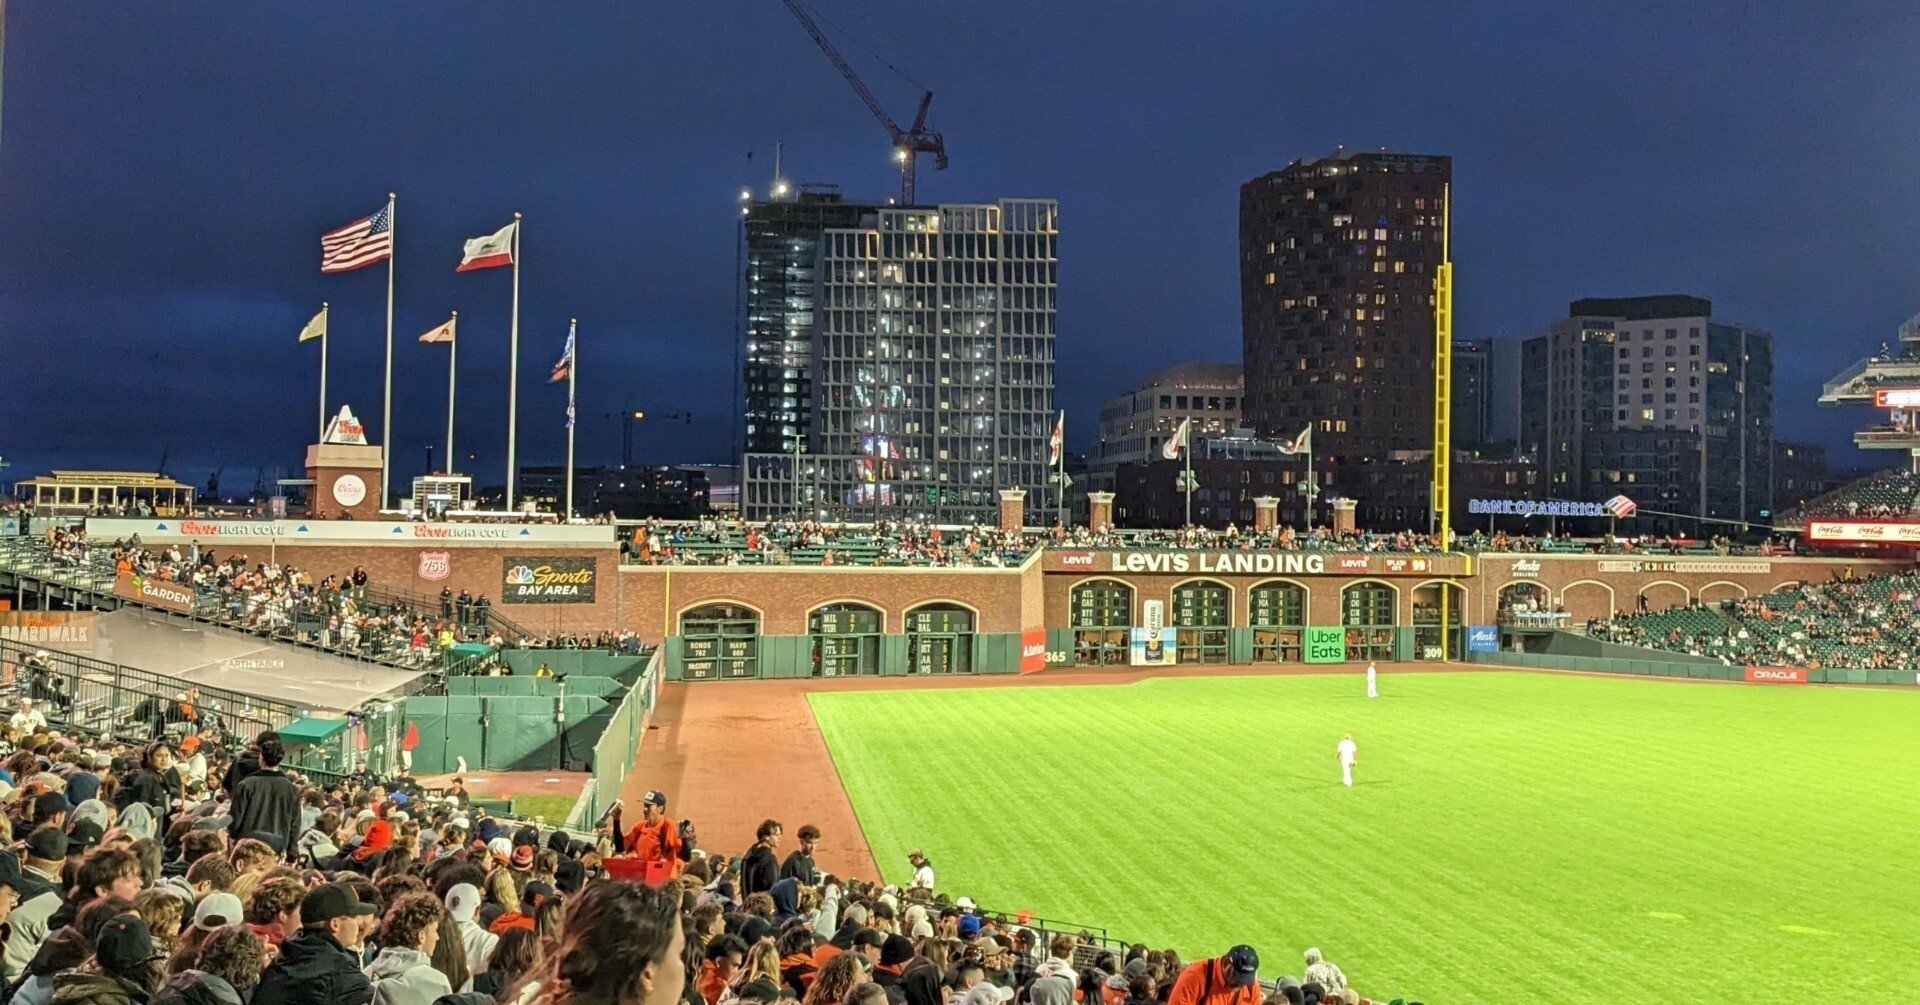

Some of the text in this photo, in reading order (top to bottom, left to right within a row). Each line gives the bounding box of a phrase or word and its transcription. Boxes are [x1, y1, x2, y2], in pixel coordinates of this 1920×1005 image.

[1469, 499, 1603, 517] BANK OF AMERICA
[181, 520, 285, 535] Coors LIGHT COVE
[414, 524, 509, 538] Coors LIGHT COVE
[1818, 526, 1844, 534] Coca-Cola
[1858, 526, 1884, 535] Coca-Cola
[424, 561, 446, 571] 756
[1200, 553, 1324, 573] LANDING
[1511, 560, 1541, 572] Alaska
[532, 565, 593, 587] Sports
[142, 585, 191, 604] GARDEN
[518, 585, 578, 595] BAY AREA
[1082, 590, 1094, 598] ATL
[1081, 599, 1094, 607] OAK
[918, 614, 931, 622] CLE
[1181, 609, 1193, 617] COL
[823, 614, 837, 623] MIL
[822, 624, 836, 633] TOR
[918, 623, 931, 632] BAL
[1311, 630, 1341, 643] Uber
[1045, 651, 1066, 662] 365
[1311, 645, 1341, 659] Eats
[1424, 648, 1443, 659] 309
[255, 660, 283, 668] TABLE
[1753, 671, 1798, 679] ORACLE
